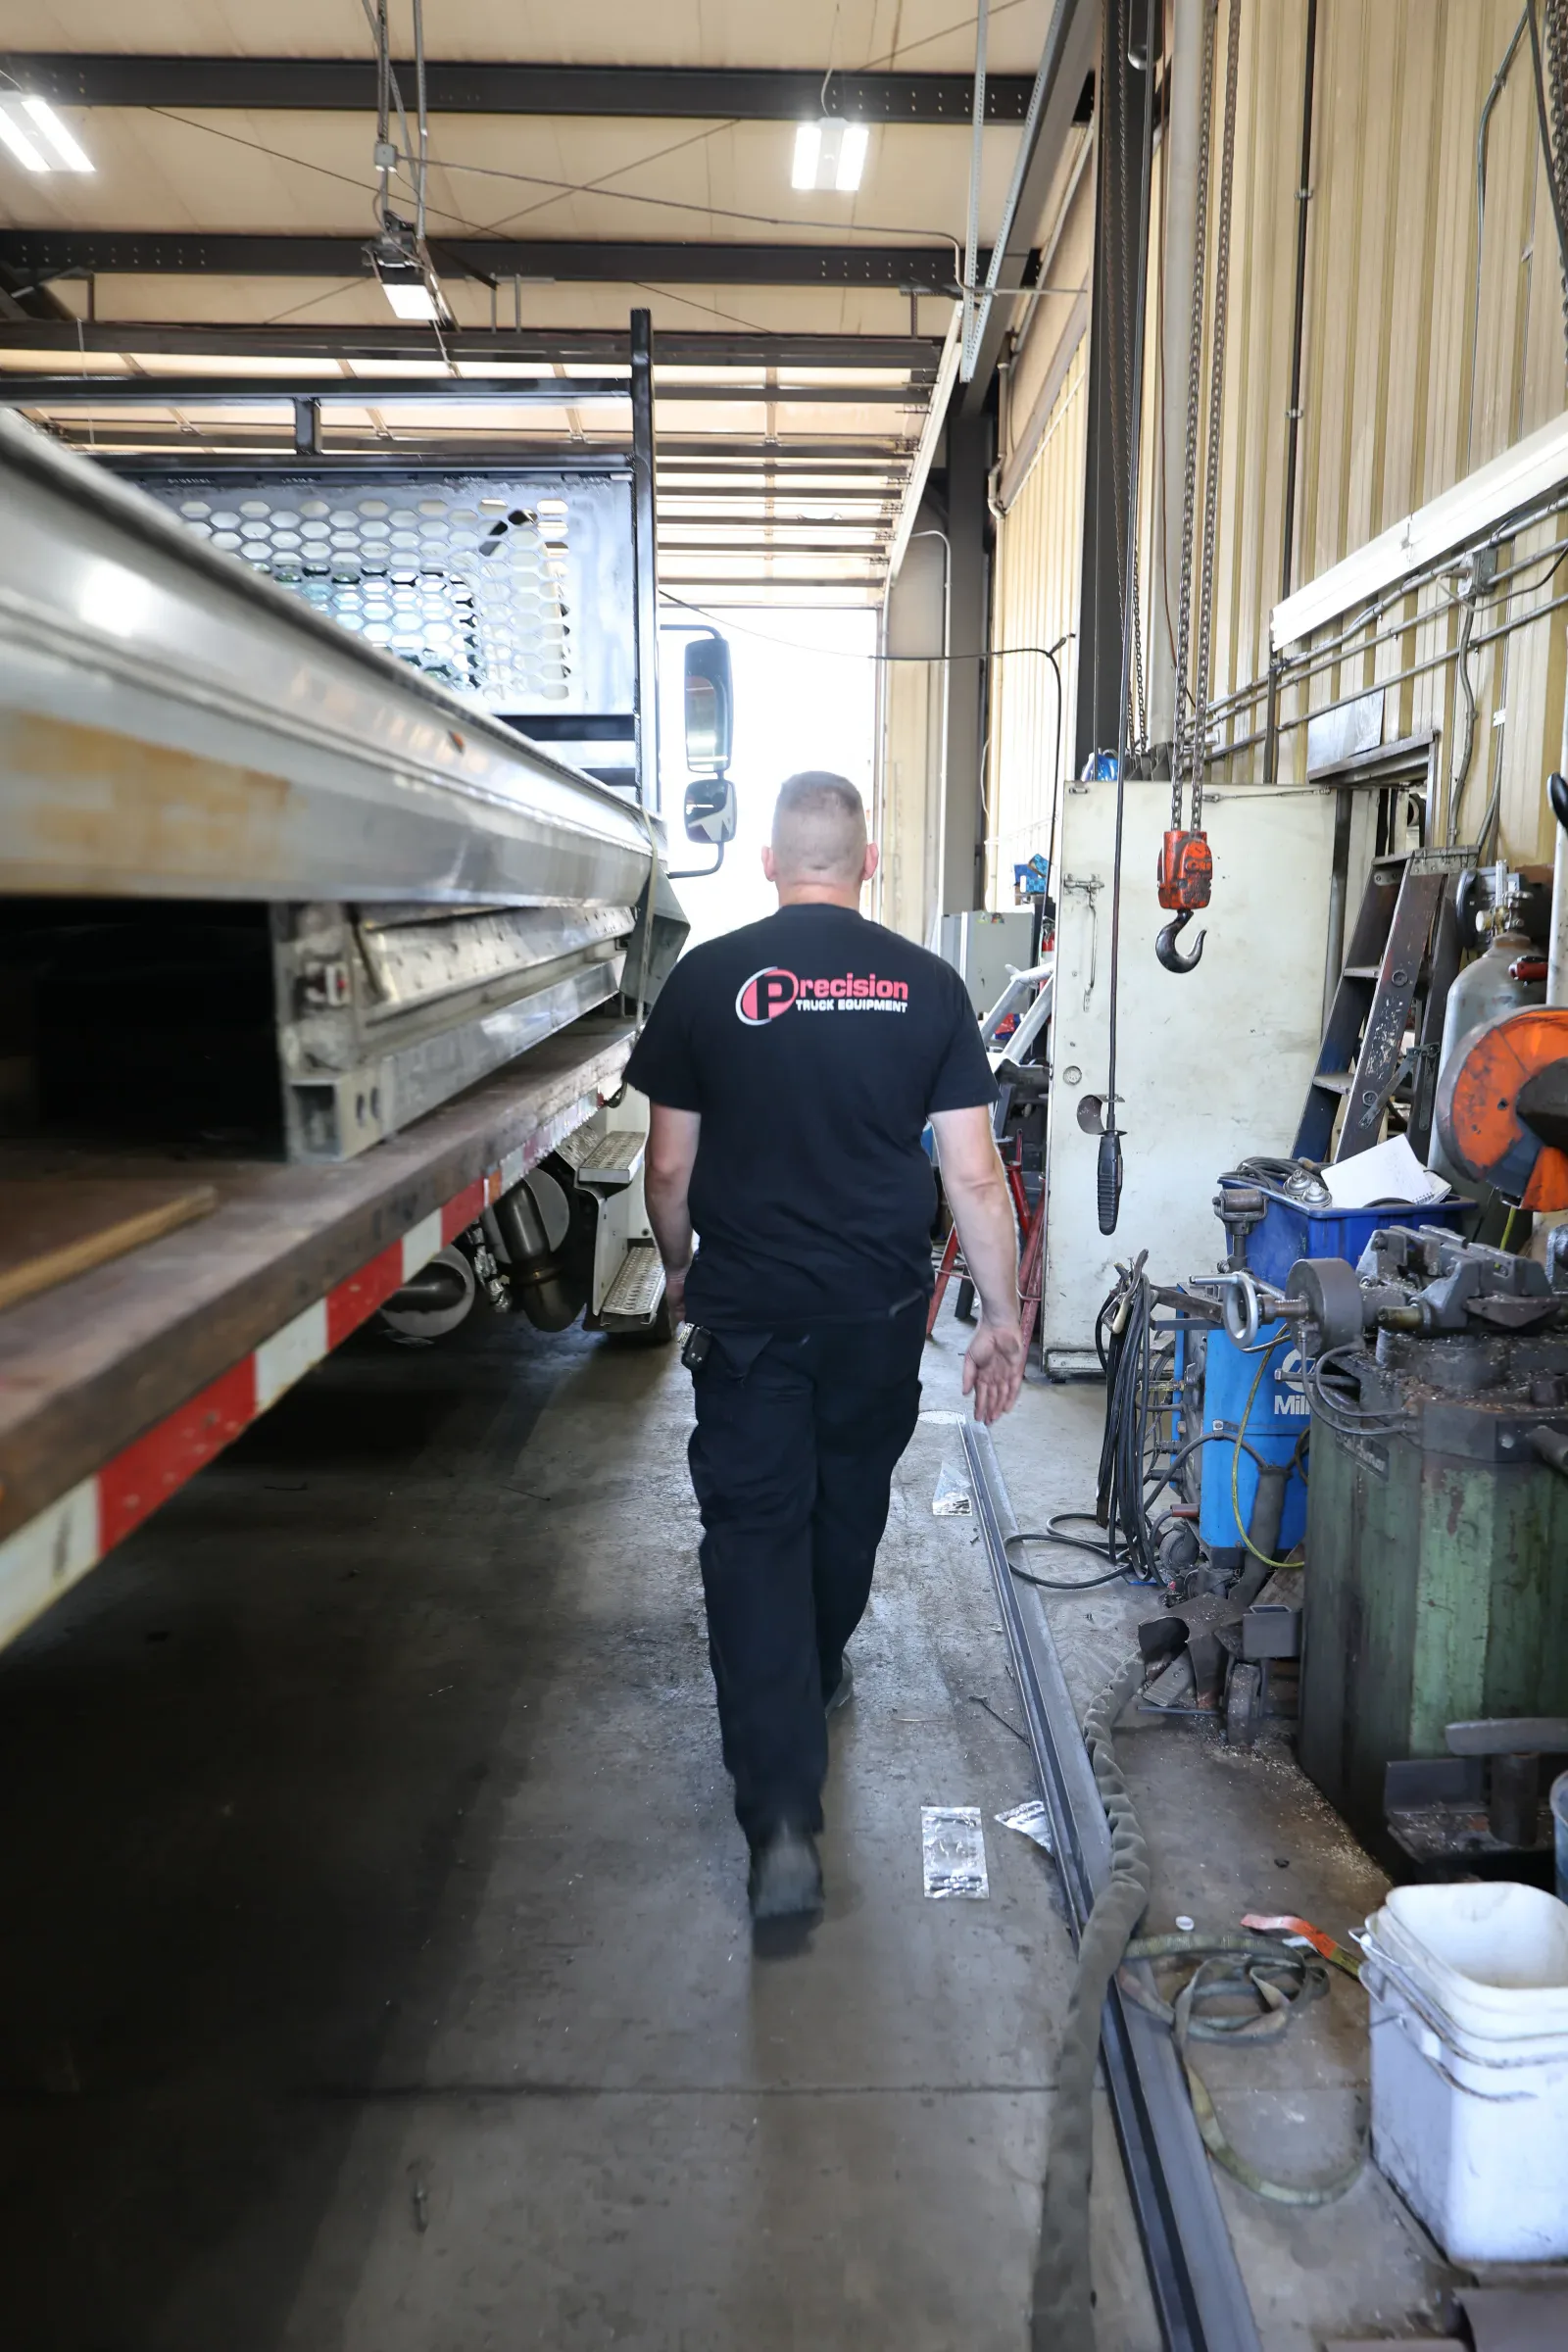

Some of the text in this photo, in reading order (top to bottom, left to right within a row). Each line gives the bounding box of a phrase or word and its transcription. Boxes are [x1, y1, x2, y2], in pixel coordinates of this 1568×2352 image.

[741, 968, 908, 1021] Precision
[796, 999, 907, 1013] TRUCK EQUIPMENT
